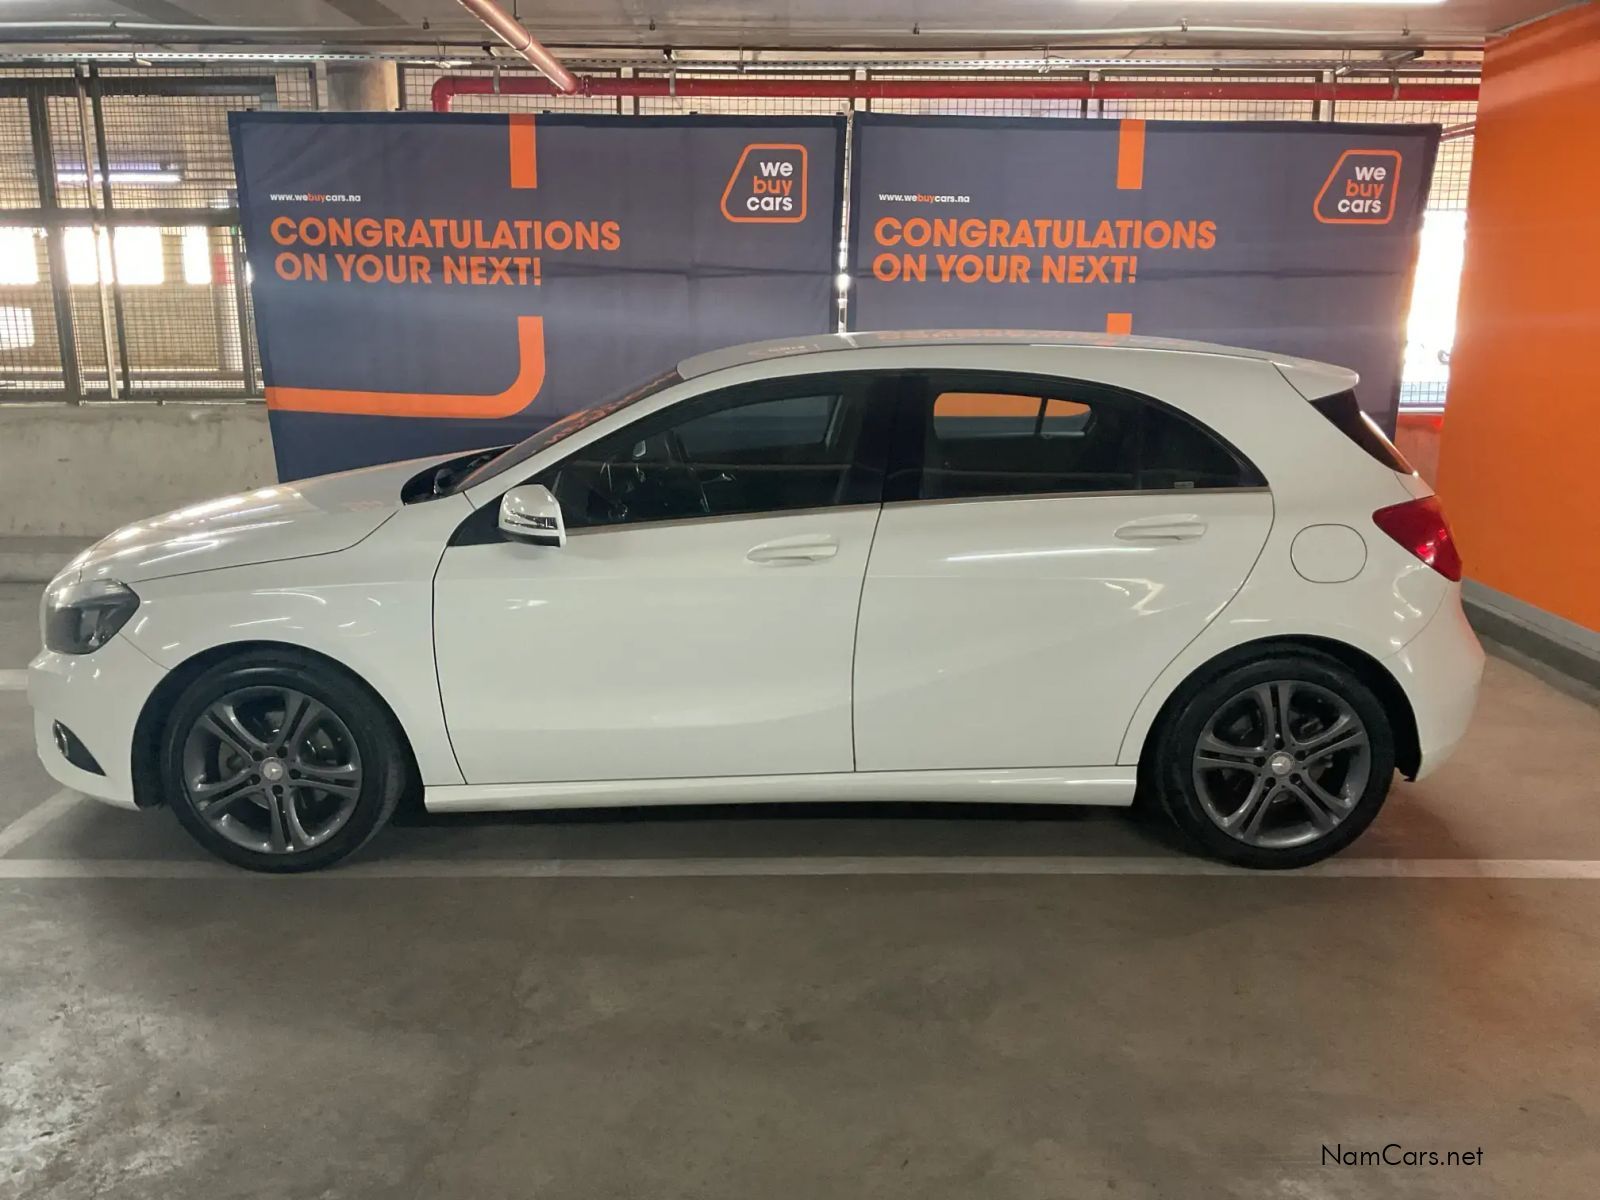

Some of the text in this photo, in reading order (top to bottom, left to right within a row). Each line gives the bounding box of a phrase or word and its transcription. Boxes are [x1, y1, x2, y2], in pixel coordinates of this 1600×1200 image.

[760, 162, 793, 177] we
[1355, 166, 1386, 181] we
[753, 176, 793, 196] buy
[1345, 179, 1384, 199] buy
[270, 192, 361, 203] www.webuycars.na
[746, 196, 793, 211] cars
[879, 193, 970, 203] www.webuycars.na
[1338, 199, 1382, 213] cars
[271, 216, 621, 250] CONGRATULATIONS
[874, 216, 1217, 249] CONGRATULATIONS
[275, 252, 541, 286] ON YOUR NEXT!
[872, 252, 1137, 284] ON YOUR NEXT!
